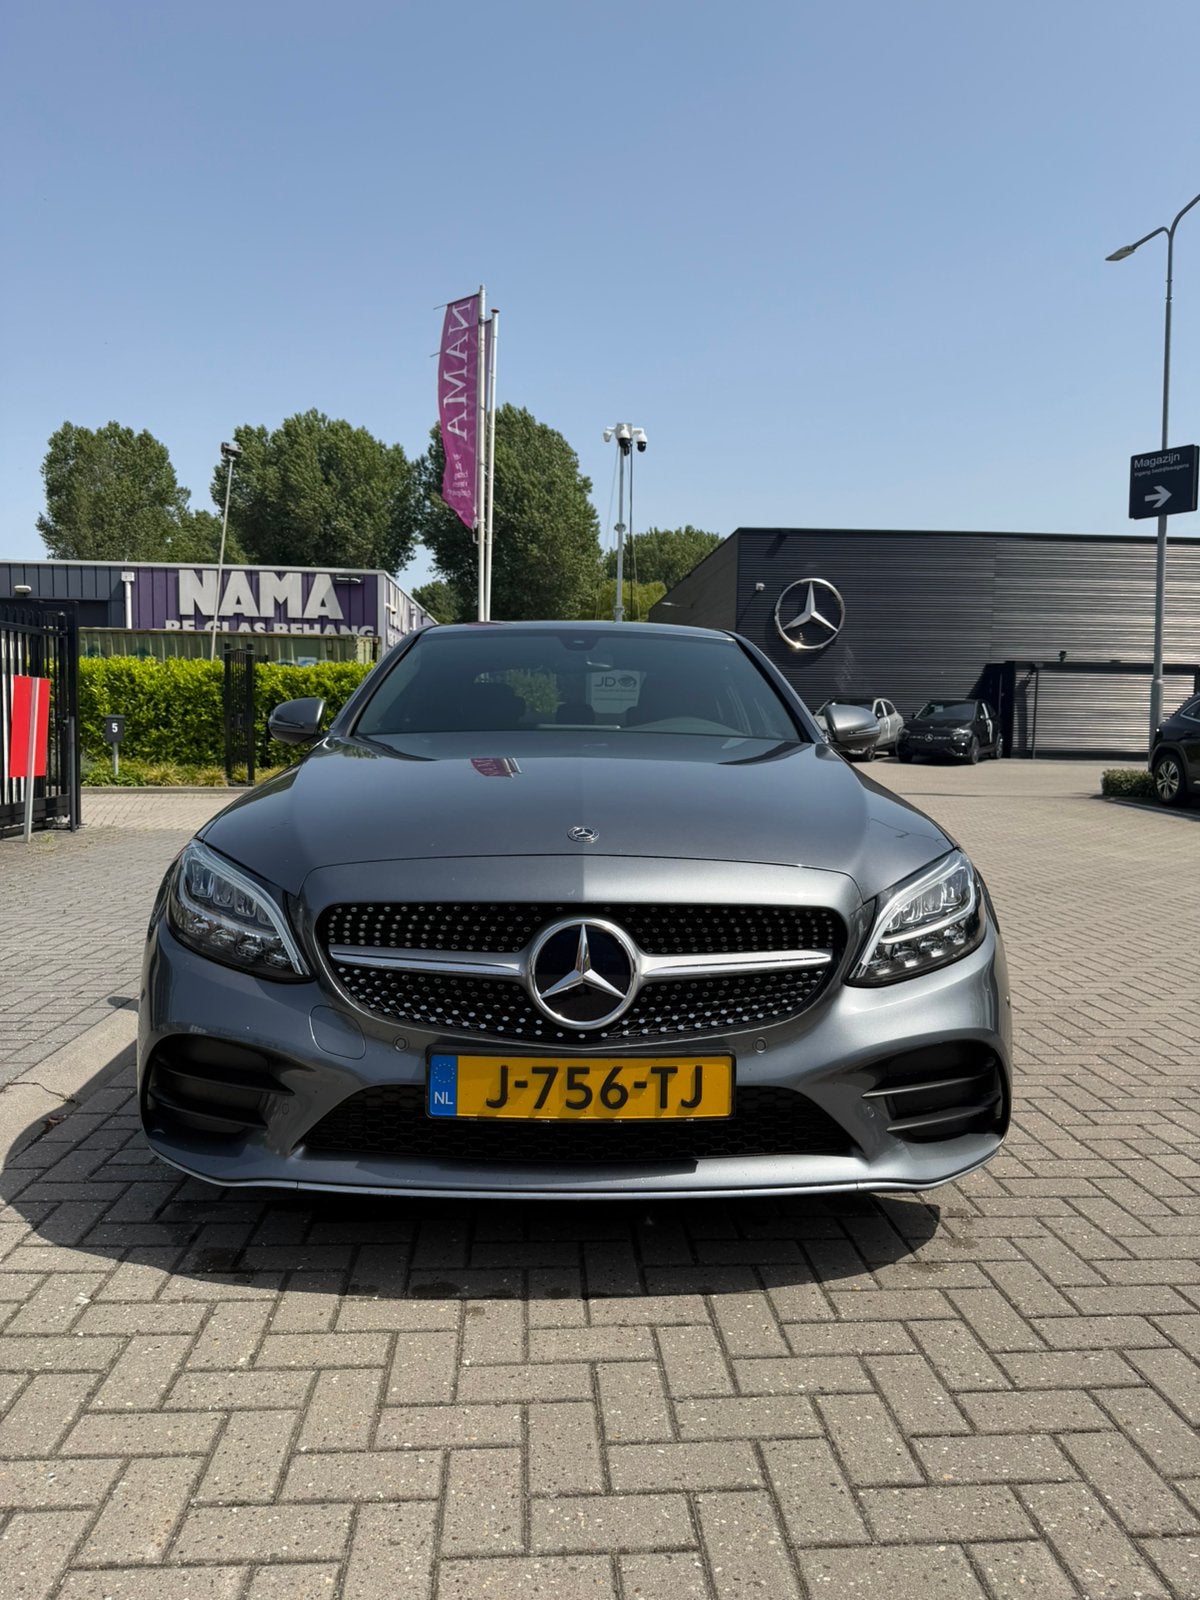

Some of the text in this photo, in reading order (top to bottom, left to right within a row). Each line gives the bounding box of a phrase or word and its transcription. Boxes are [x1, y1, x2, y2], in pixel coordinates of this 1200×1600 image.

[1134, 453, 1180, 469] Magazijn
[178, 569, 344, 620] NAMA
[111, 722, 119, 733] 5
[485, 1065, 703, 1110] J-756-TJ
[434, 1091, 454, 1105] NL
